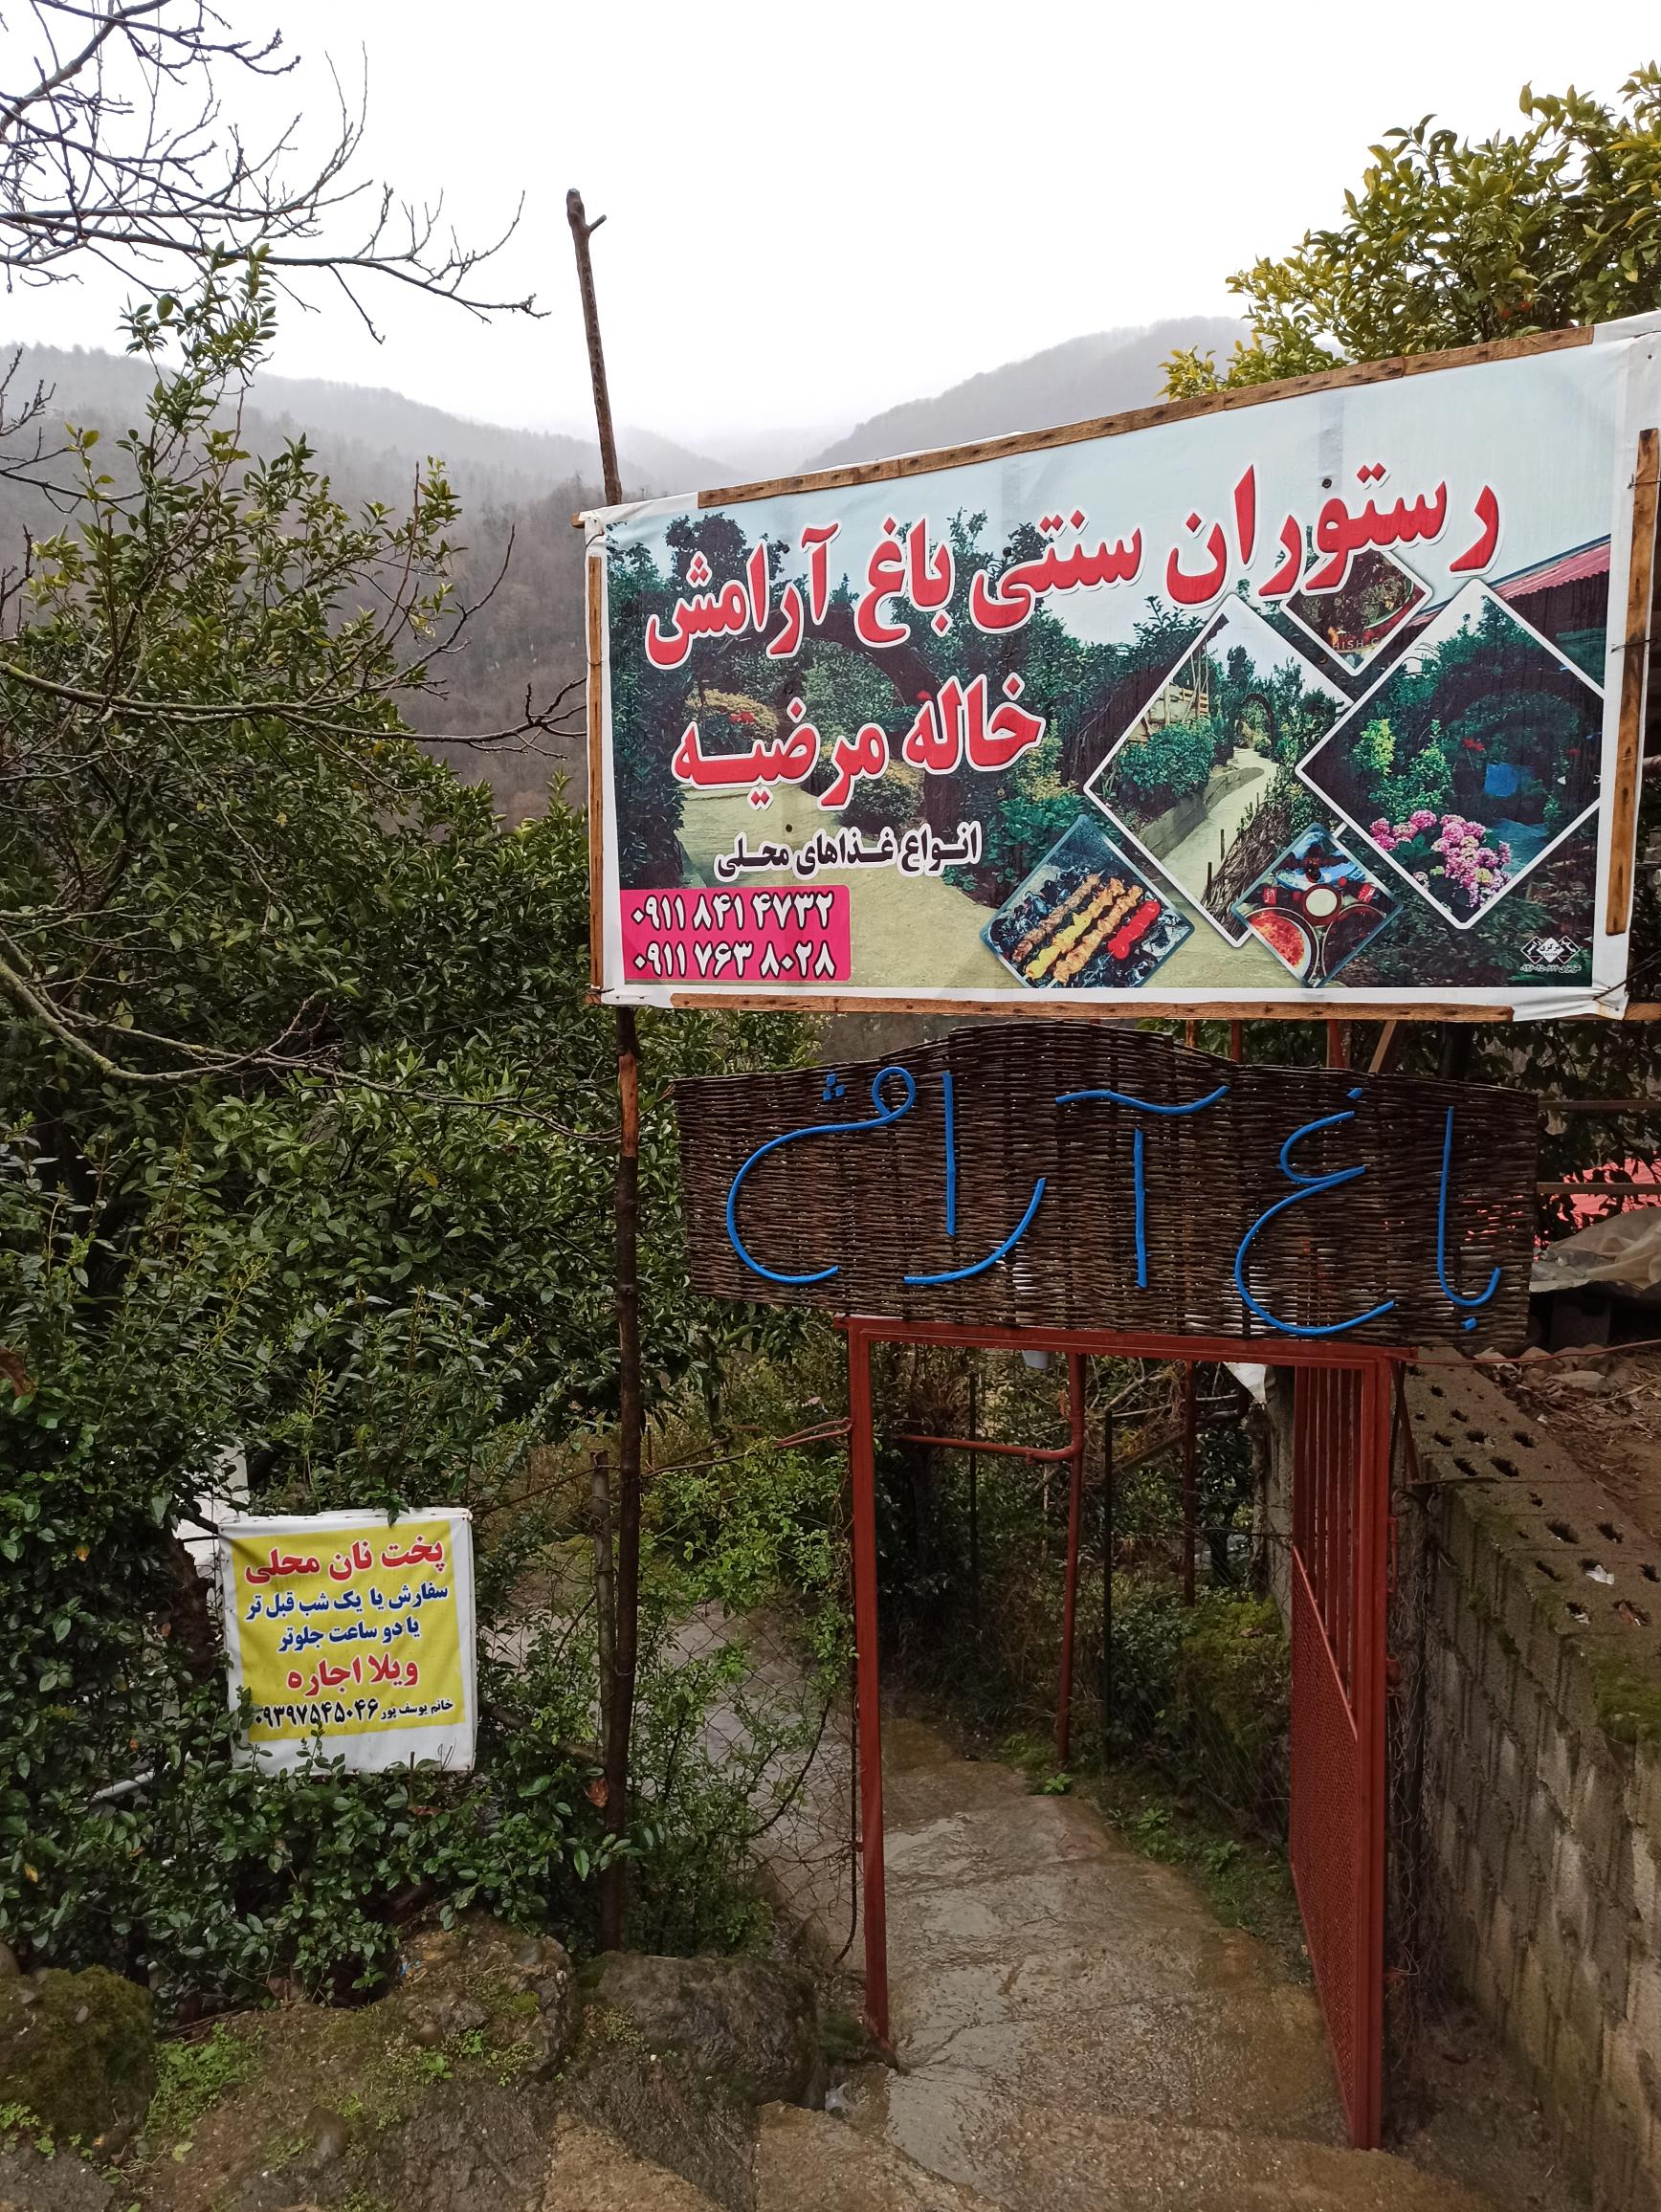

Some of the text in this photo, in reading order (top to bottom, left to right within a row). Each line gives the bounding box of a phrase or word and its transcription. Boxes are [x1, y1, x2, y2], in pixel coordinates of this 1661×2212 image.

[647, 461, 1500, 666] رستوران سنتی باغ آرامش
[673, 676, 1044, 807] خاله مرضیه
[718, 826, 978, 877] انواع غذاهای محلی
[631, 890, 834, 931] ۰۹۱۱ ۸۴۱ ۴۷۳۲
[633, 940, 836, 978] ۰۹۱۱ ۷۶۳ ۸۰۲۸
[1233, 1086, 1501, 1338] باغ
[245, 1534, 444, 1584] پخت نان محلی
[245, 1582, 449, 1621] سفارش یا یک شب قبل تر
[277, 1616, 420, 1652] یا دو ساعت جلوتر
[286, 1652, 419, 1697] ویلا اجاره
[380, 1706, 397, 1721] پور
[398, 1702, 429, 1717] یوسف
[431, 1698, 454, 1714] خانم
